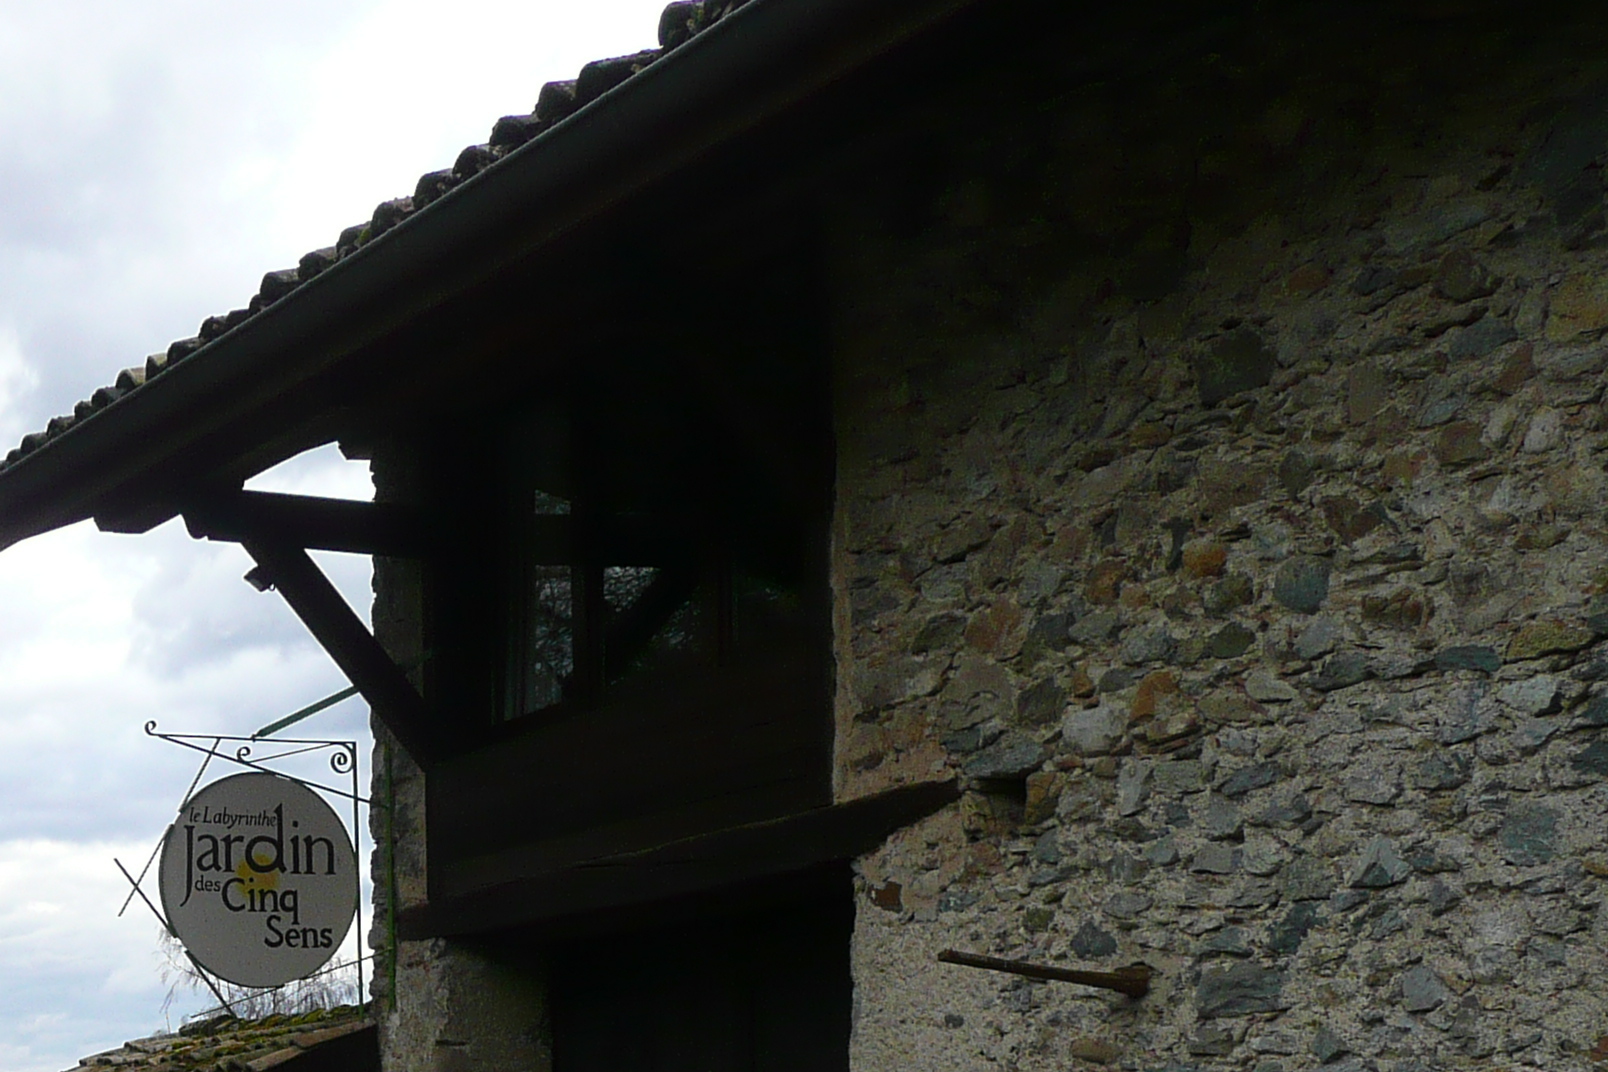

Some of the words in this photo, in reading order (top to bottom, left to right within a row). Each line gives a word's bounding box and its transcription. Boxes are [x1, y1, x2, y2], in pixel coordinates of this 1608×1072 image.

[189, 807, 201, 823] le
[203, 806, 278, 829] Labyrinthe
[180, 803, 336, 907] Jardin
[195, 876, 221, 892] des
[221, 877, 298, 925] Cinq
[264, 915, 333, 949] Sens
